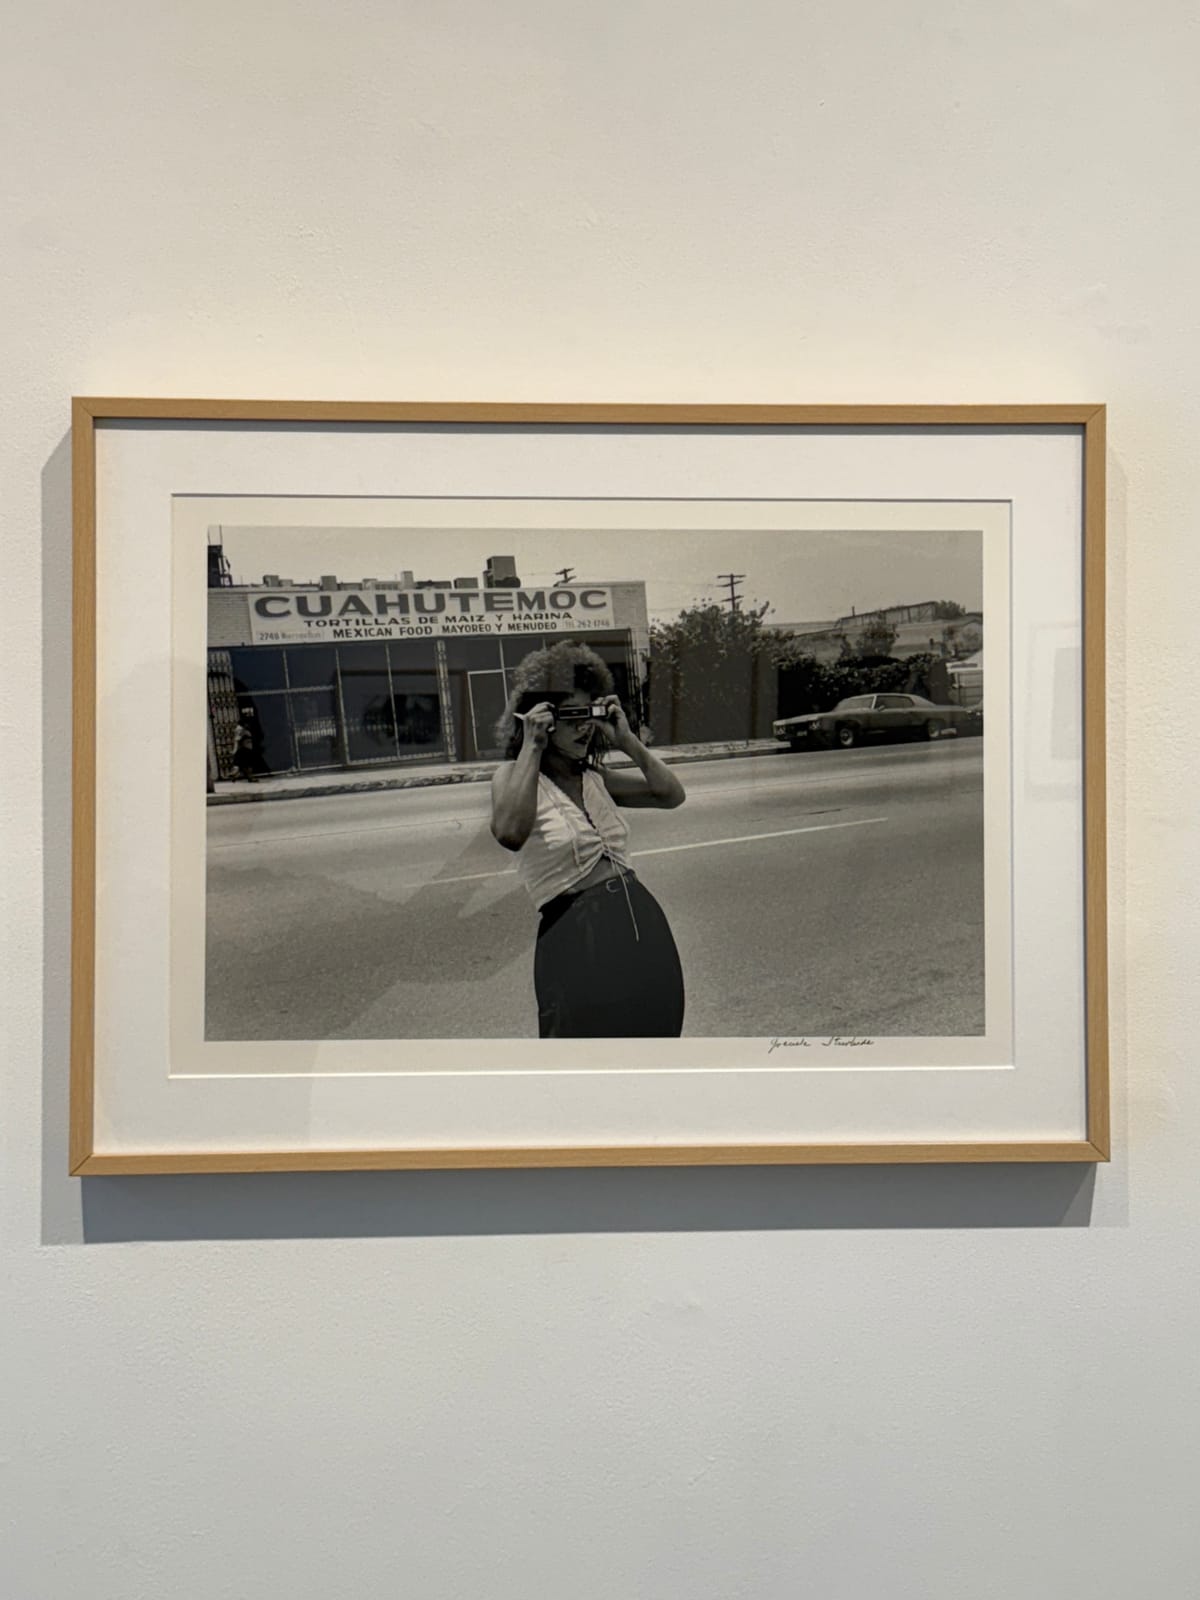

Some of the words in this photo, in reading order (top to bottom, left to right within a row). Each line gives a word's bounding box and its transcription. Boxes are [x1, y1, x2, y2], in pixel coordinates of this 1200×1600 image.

[254, 590, 607, 618] CUAHUTEMOC
[304, 617, 411, 627] TORTILLAS
[418, 616, 439, 624] DE
[445, 614, 485, 623] MAIZ
[512, 611, 573, 621] HARINA
[333, 627, 393, 639] MEXICAN
[400, 625, 433, 636] FOOD
[442, 622, 492, 634] MAYOREO
[495, 622, 503, 632] Y
[507, 621, 557, 631] MENUDEO
